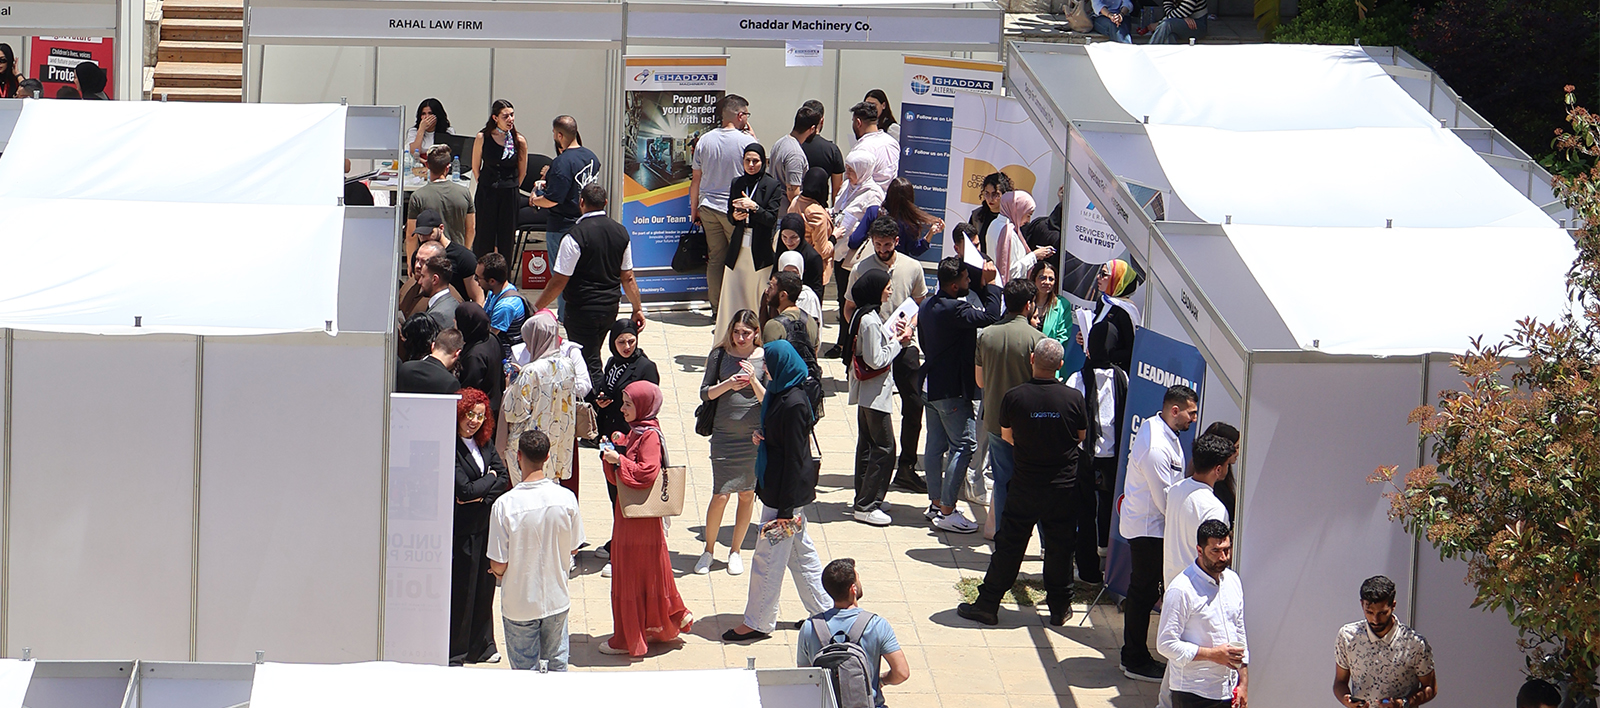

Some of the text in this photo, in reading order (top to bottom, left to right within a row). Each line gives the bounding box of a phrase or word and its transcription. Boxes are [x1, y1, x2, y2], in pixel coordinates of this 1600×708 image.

[0, 6, 10, 16] al
[389, 19, 482, 30] RAHAL LAW FIRM
[740, 20, 872, 32] Ghaddar Machinery Co.
[48, 66, 74, 82] Prote
[935, 78, 990, 89] GHADDAR
[672, 94, 717, 105] Power Up
[662, 105, 716, 116] your Career
[678, 115, 716, 124] with us!
[972, 174, 985, 182] DES
[967, 181, 983, 189] COM
[633, 214, 692, 224] Join Our Team T
[1080, 210, 1104, 220] IMPERI
[1075, 225, 1119, 242] SERVICES YOU
[1079, 234, 1115, 249] CAN TRUST
[1181, 288, 1199, 322] LEADMARK
